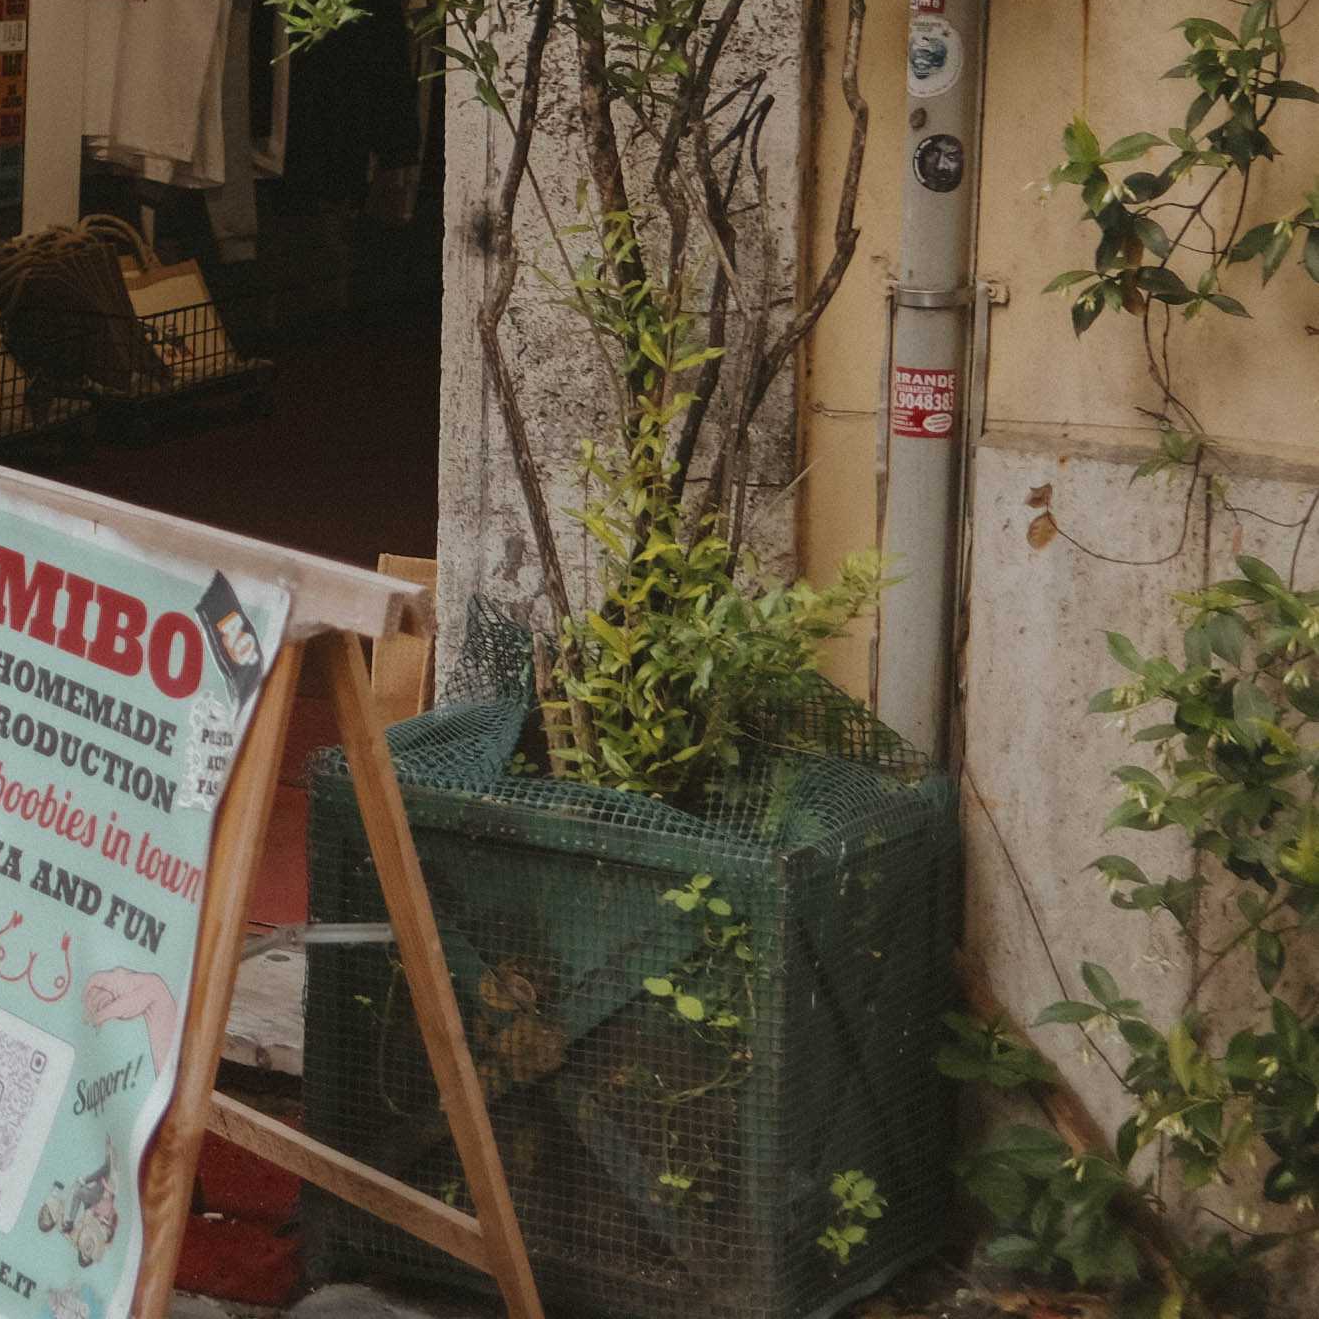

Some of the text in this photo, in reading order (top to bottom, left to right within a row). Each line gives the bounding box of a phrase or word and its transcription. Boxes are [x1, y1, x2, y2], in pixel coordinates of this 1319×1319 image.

[100, 812, 135, 862] in
[134, 832, 206, 906] town
[29, 860, 104, 917] AND
[106, 902, 167, 956] FUN
[74, 1055, 144, 1117] Support!
